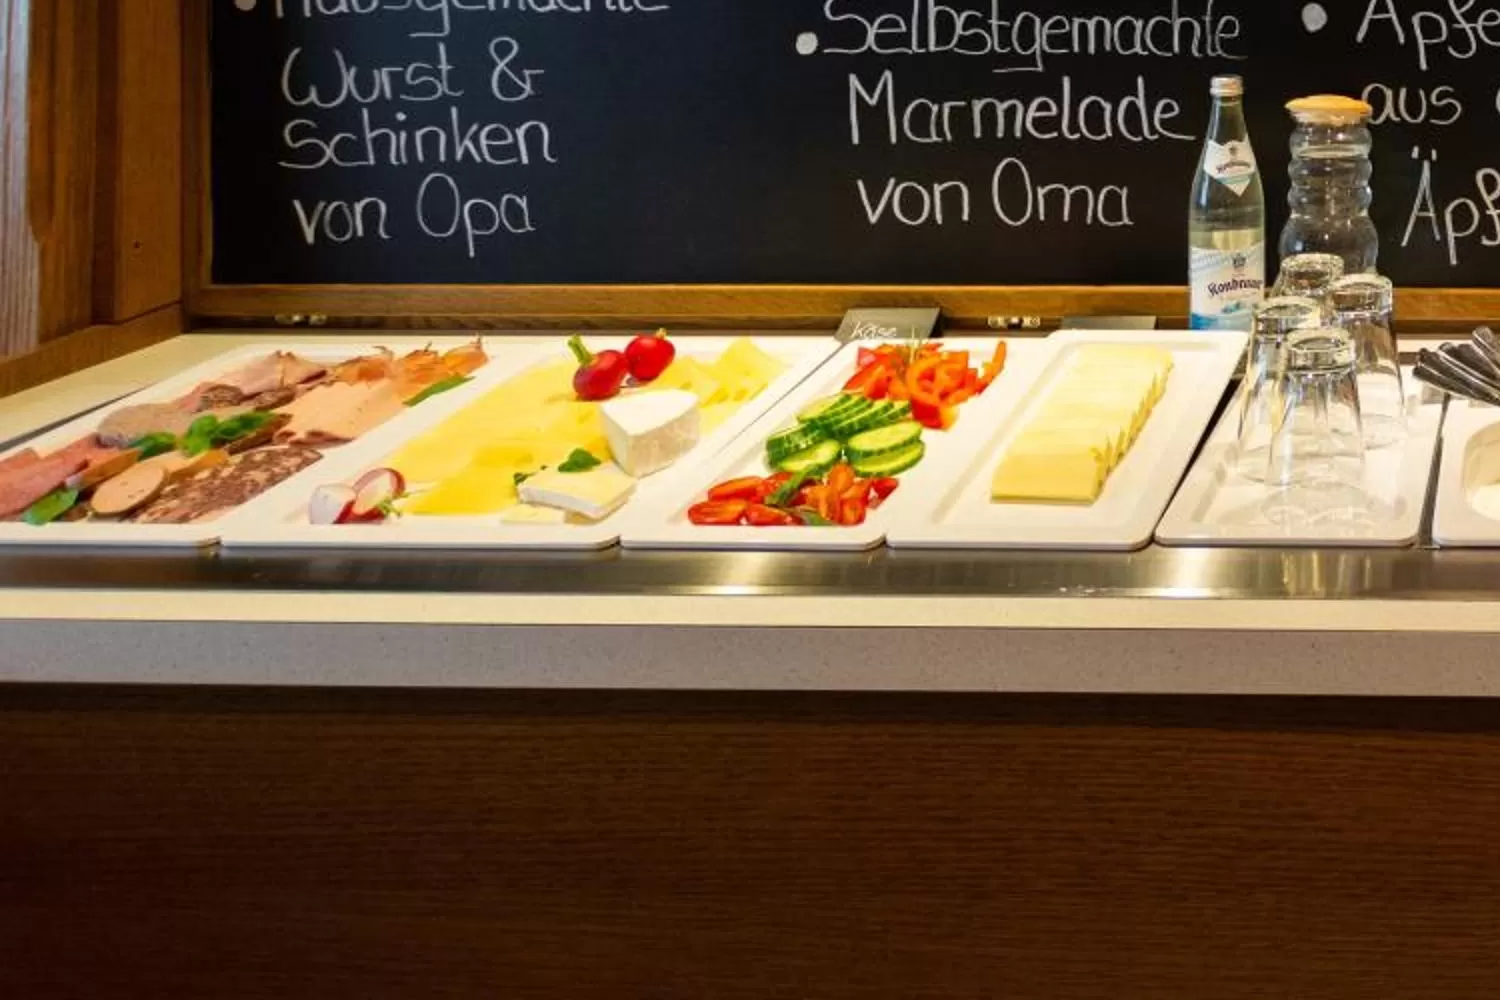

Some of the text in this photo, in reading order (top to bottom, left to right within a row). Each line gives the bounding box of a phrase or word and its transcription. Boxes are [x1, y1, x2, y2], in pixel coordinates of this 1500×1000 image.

[282, 35, 545, 108] Wurst &
[848, 69, 1196, 145] Marmelade
[1361, 82, 1462, 126] aus
[279, 106, 558, 169] Schinken
[293, 172, 536, 258] von Opa
[856, 156, 1135, 227] von Oma
